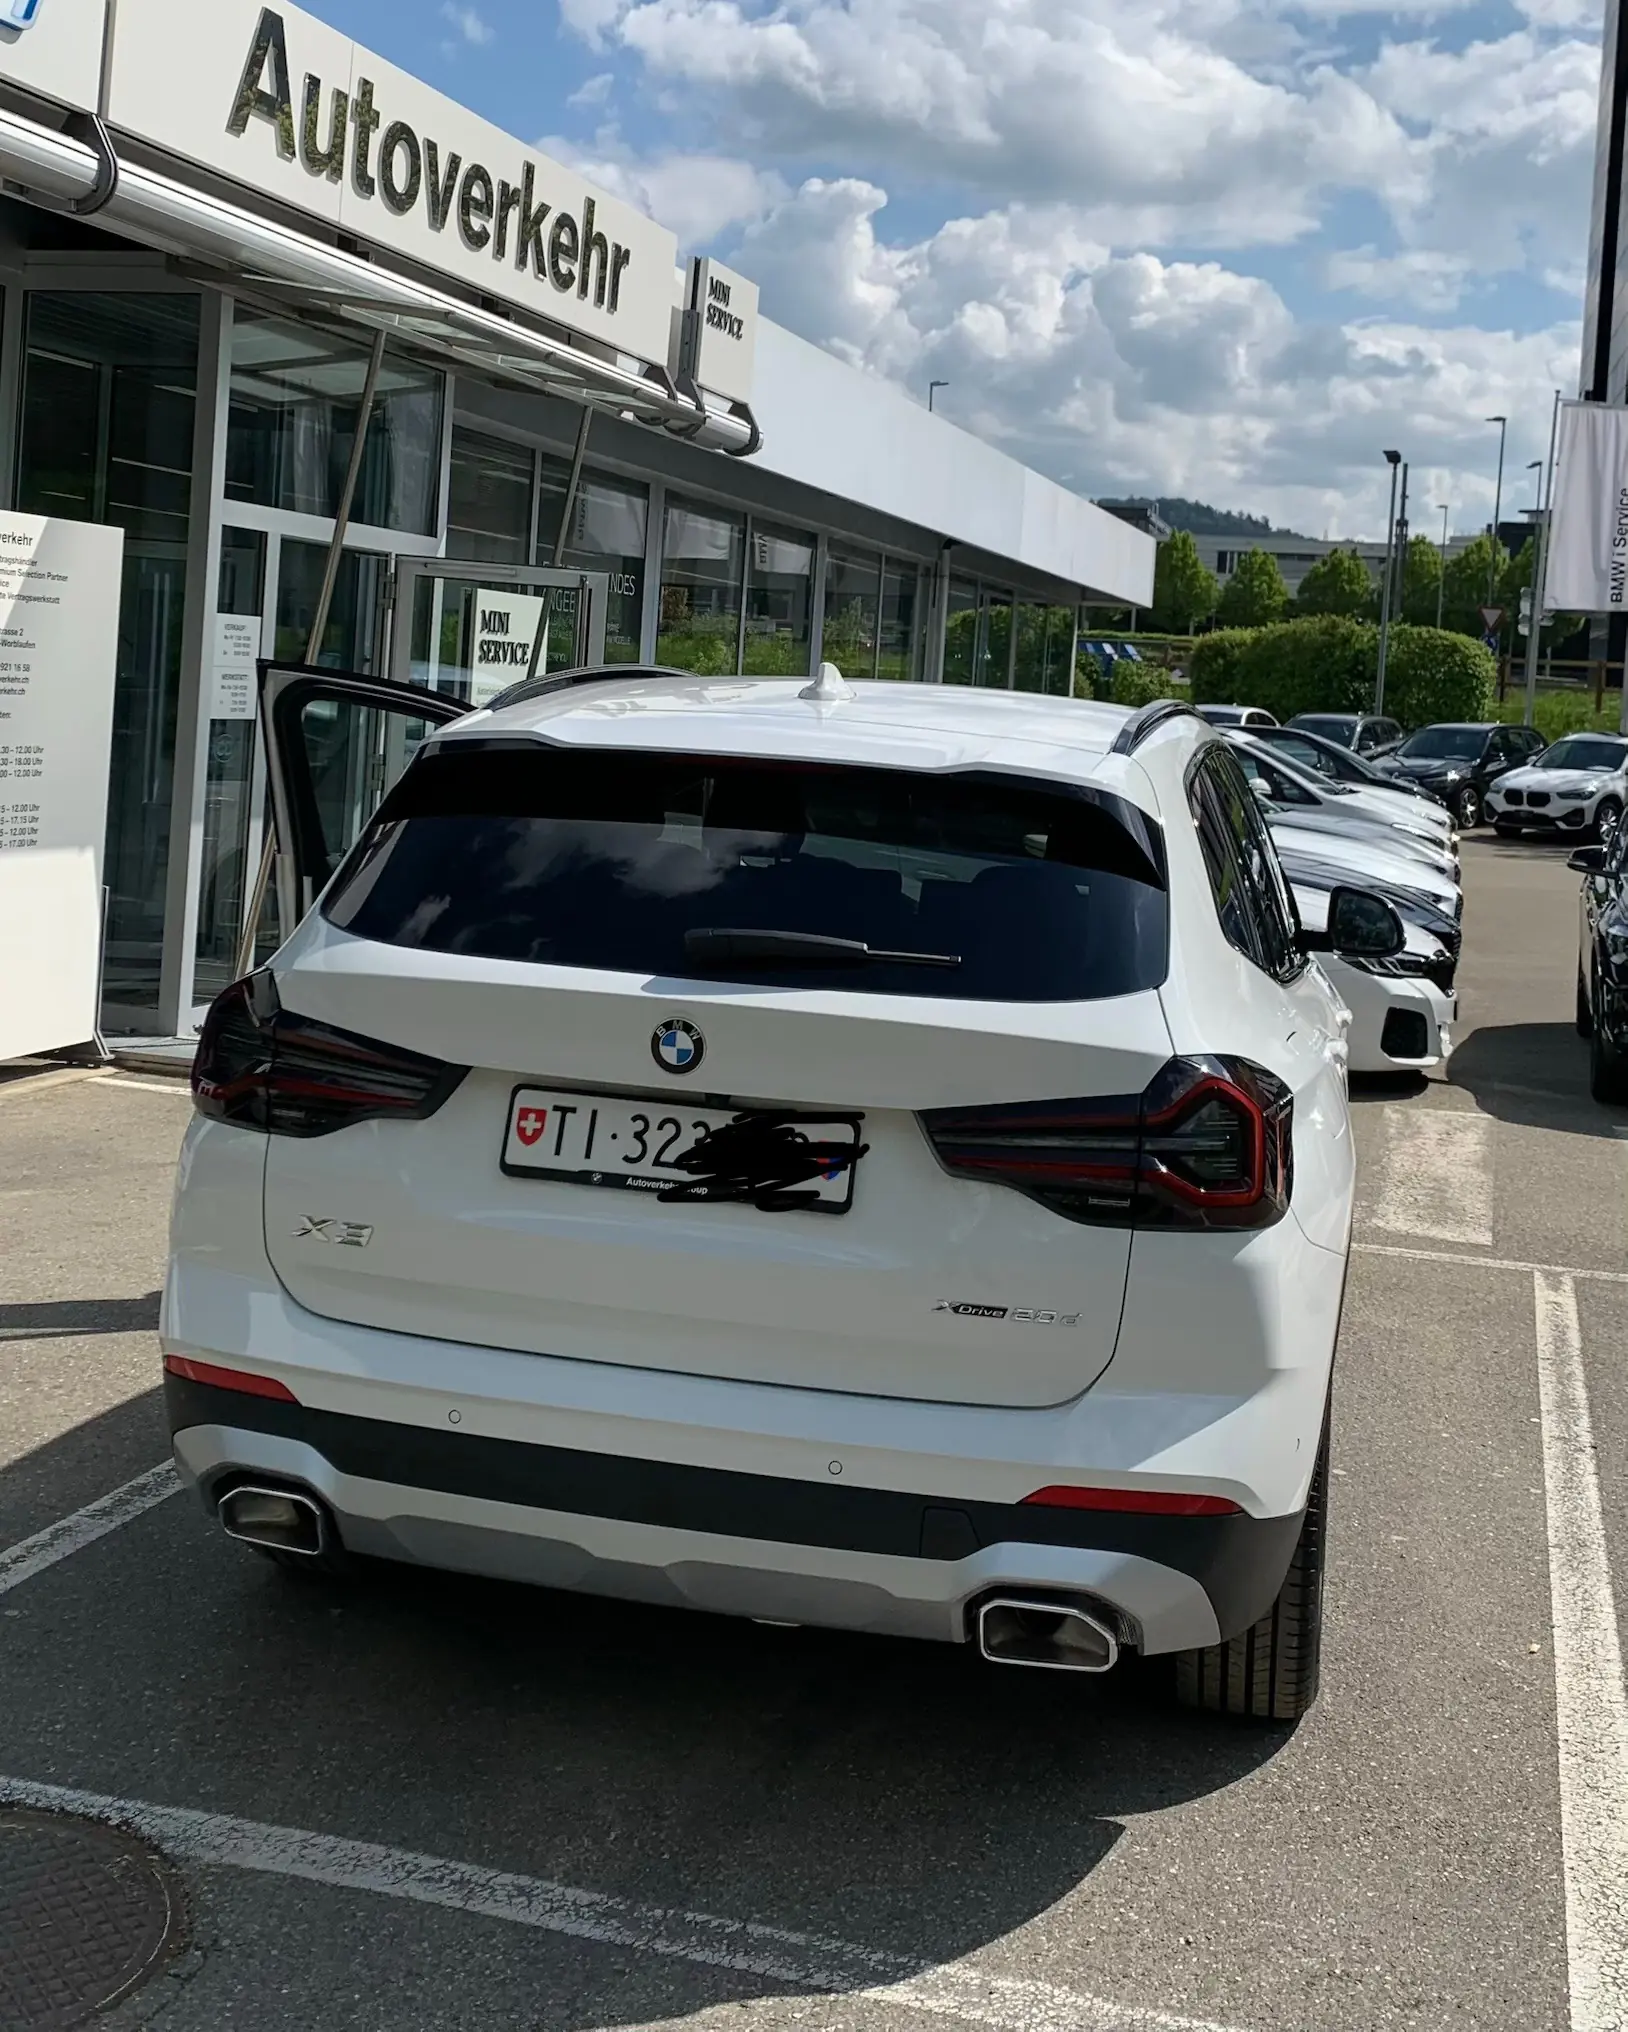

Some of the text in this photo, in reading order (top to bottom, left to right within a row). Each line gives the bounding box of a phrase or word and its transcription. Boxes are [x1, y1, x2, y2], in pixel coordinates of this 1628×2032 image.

[225, 5, 630, 314] Autoverkehr
[708, 276, 731, 308] MINI
[705, 302, 744, 341] SERVICE
[1612, 487, 1628, 548] Service
[46, 571, 68, 582] Partner
[1610, 560, 1625, 603] BMW
[480, 609, 511, 637] MINI
[19, 628, 24, 637] 2
[477, 639, 530, 667] SERVICE
[15, 745, 32, 754] 12.00
[33, 745, 44, 754] Uhr
[32, 757, 43, 766] Uhr
[14, 769, 30, 778] 12.00
[31, 769, 42, 777] Uhr
[11, 804, 28, 813] 12.00
[29, 804, 40, 812] Uhr
[28, 816, 39, 824] Uhr
[10, 828, 26, 836] 12.00
[27, 827, 39, 836] Uhr
[9, 839, 25, 849] 17.00
[26, 838, 38, 848] Uhr
[656, 1020, 702, 1040] BMW
[290, 1214, 374, 1248] X3
